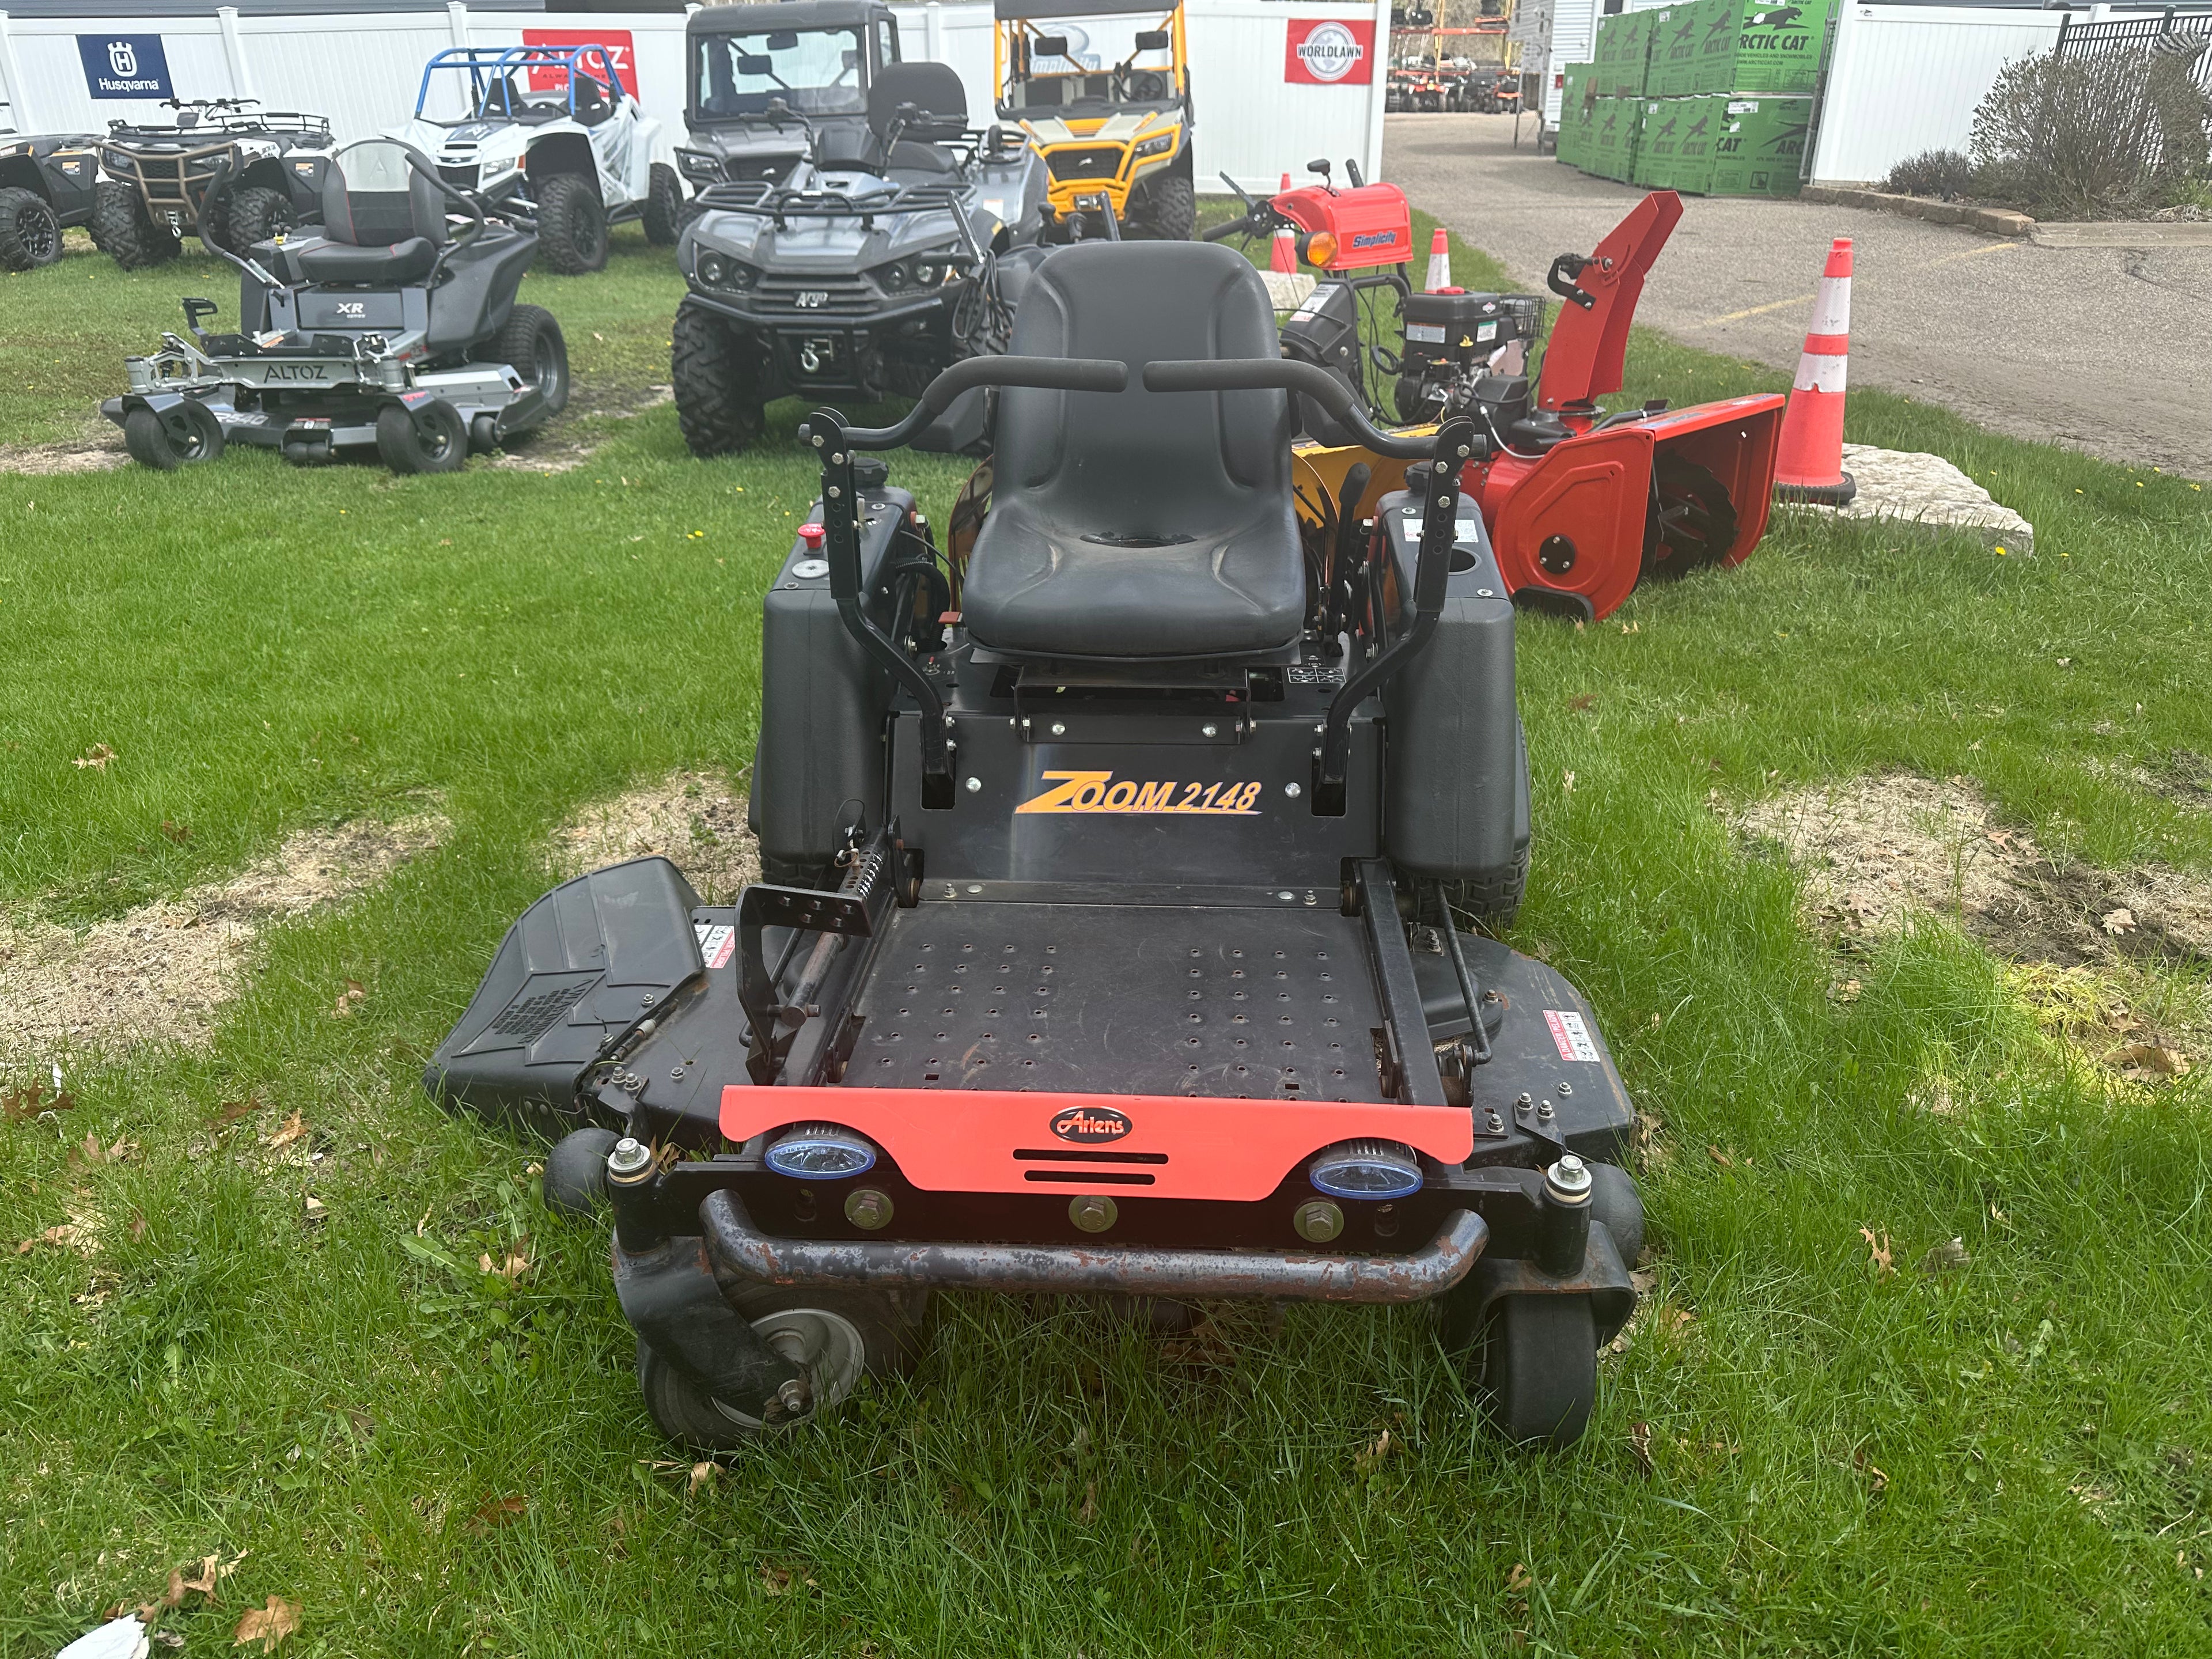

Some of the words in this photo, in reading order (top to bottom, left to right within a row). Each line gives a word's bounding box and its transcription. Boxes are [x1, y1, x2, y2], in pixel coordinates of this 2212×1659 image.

[1738, 34, 1779, 49] RCTIC
[1781, 35, 1809, 50] CAT
[1298, 46, 1361, 58] WORLDLAWN
[99, 78, 159, 92] Husqvarna
[1717, 138, 1741, 152] CAT
[1352, 230, 1396, 249] Simplicity
[336, 302, 363, 313] XR
[264, 365, 328, 383] ALTOZ
[1014, 770, 1178, 815] ZOOM
[1174, 781, 1262, 812] 2148
[1056, 1111, 1124, 1134] Ariens
